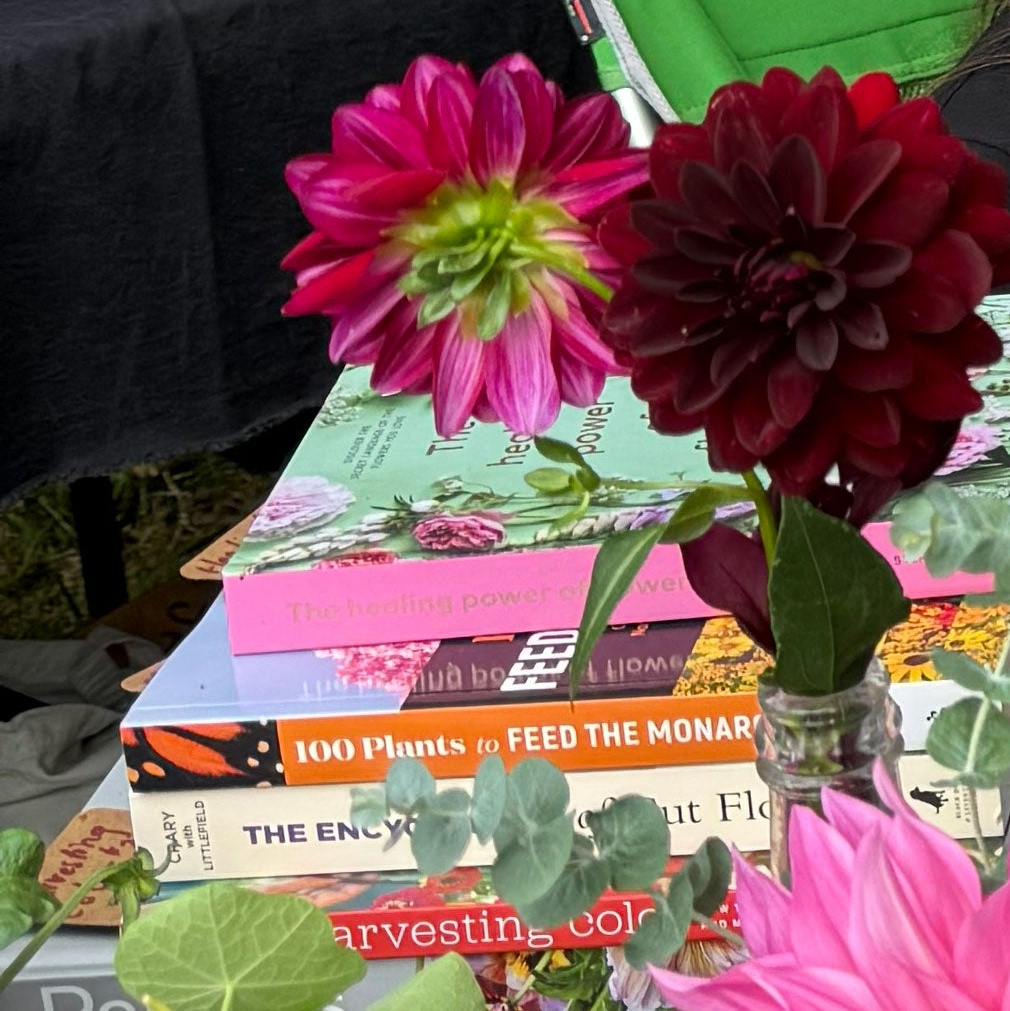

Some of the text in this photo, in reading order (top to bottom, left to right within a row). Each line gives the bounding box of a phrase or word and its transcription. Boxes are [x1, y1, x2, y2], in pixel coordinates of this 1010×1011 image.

[463, 588, 550, 613] power
[501, 630, 579, 691] FEED
[294, 738, 356, 763] 100
[361, 735, 467, 759] Plants
[476, 736, 500, 754] to
[507, 724, 577, 752] FEED
[583, 720, 640, 747] THE
[182, 824, 195, 849] with
[194, 800, 214, 871] LITTLEFIELD
[242, 822, 308, 845] THE
[332, 910, 554, 950] arvesting
